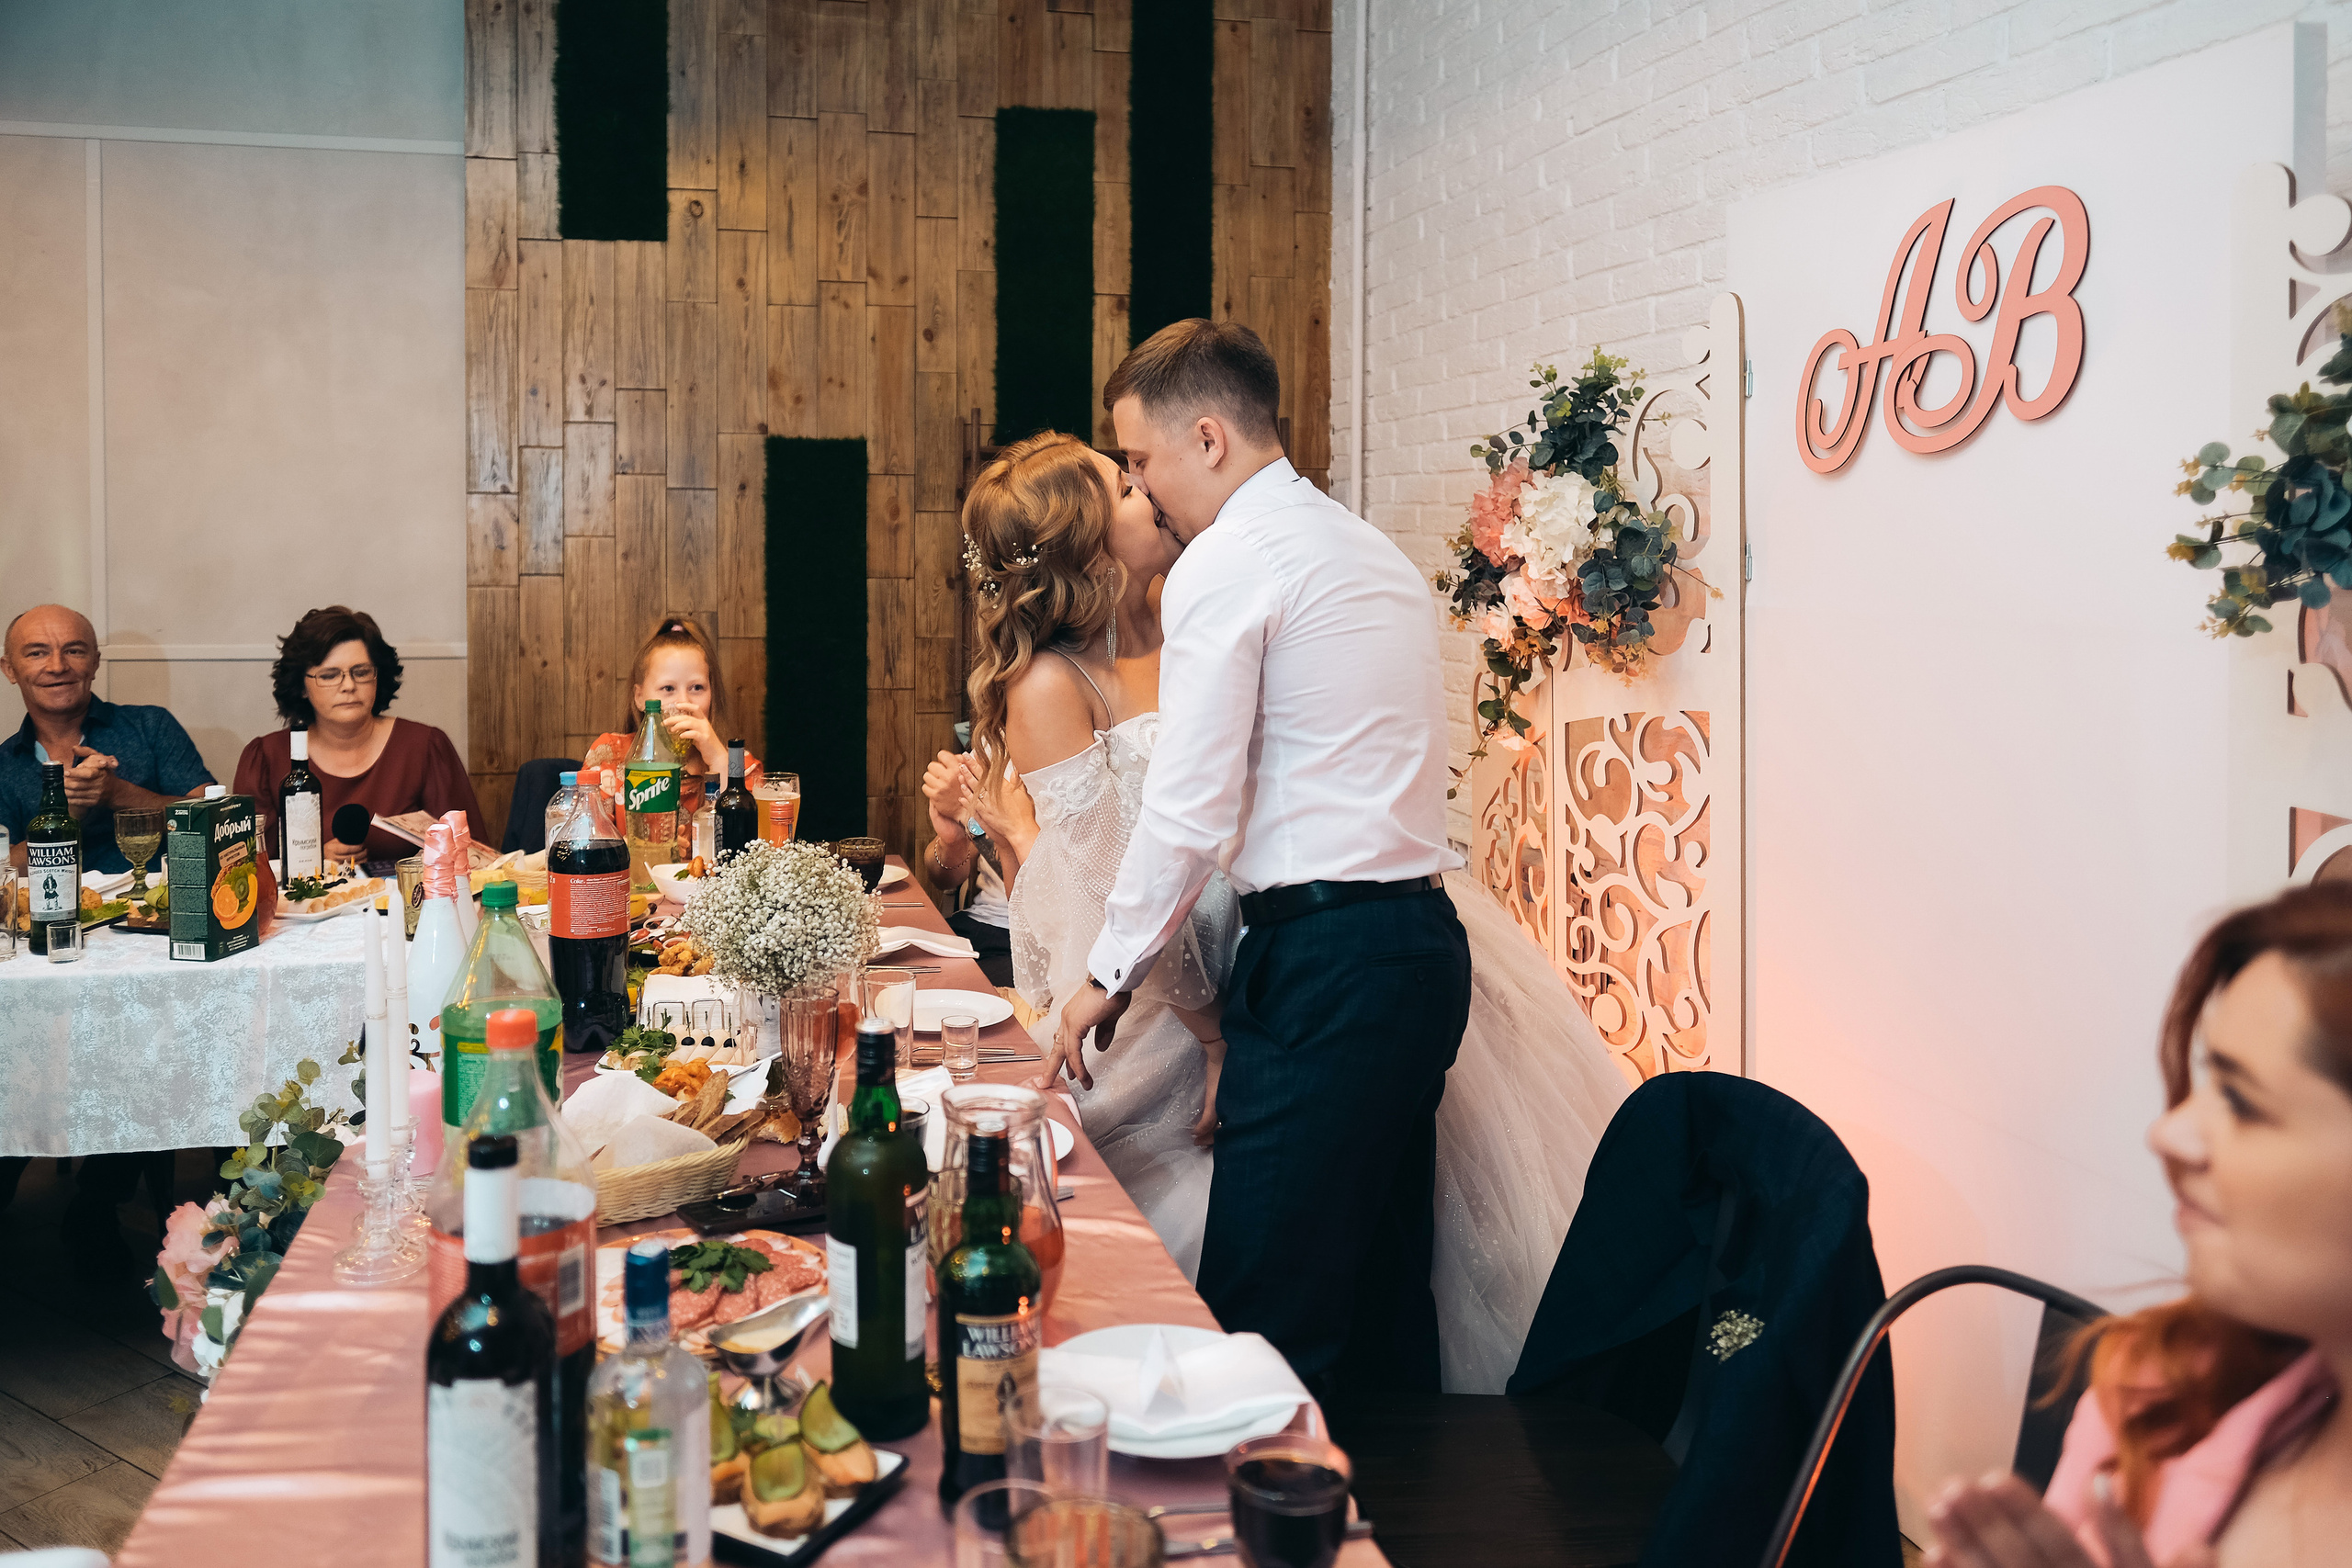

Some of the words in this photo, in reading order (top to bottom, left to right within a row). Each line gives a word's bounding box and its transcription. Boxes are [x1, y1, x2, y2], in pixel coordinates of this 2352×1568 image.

[628, 777, 670, 810] Sprite
[214, 816, 251, 842] Добрый
[28, 855, 76, 866] LAWSON'S
[29, 847, 74, 857] WILLIAM
[962, 1337, 1037, 1359] LAWSO
